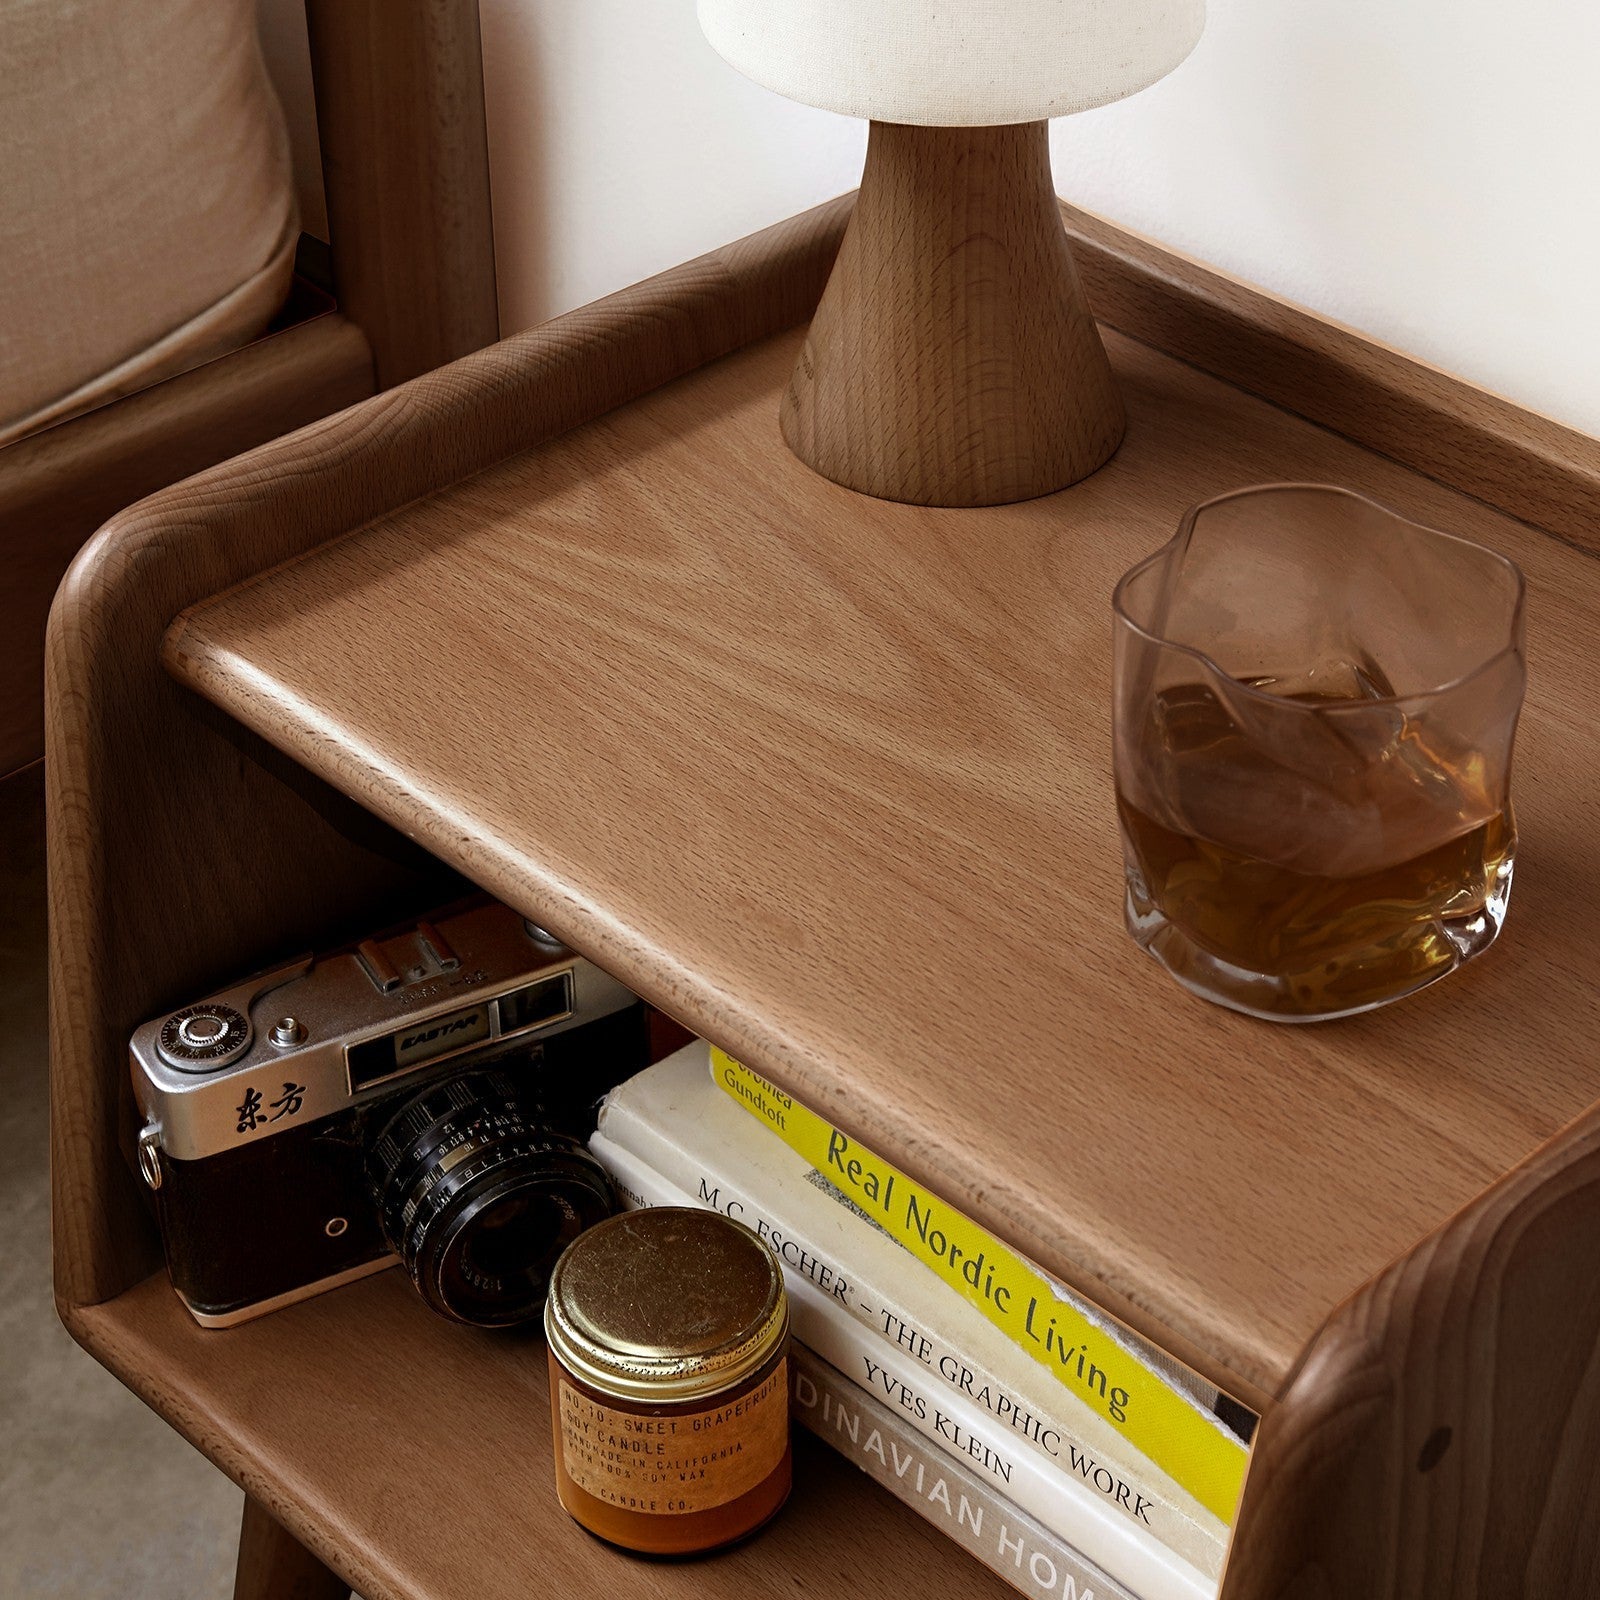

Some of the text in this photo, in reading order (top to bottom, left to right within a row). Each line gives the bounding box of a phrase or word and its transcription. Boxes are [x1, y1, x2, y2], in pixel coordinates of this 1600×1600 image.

[401, 1014, 480, 1051] EASTAR
[236, 1082, 307, 1133] 东方
[724, 1068, 787, 1131] Gundtoft
[827, 1128, 1131, 1424] Real Nordic Living
[567, 1408, 666, 1456] SOY CANDLE
[624, 1418, 678, 1435] SWEET
[863, 1356, 1014, 1484] YVES KLEIN
[880, 1308, 934, 1365] THE
[939, 1355, 1062, 1457] GRAPHIC
[1069, 1444, 1156, 1526] WORK
[632, 1458, 647, 1469] IN
[656, 1442, 744, 1470] CALIFORNIA
[641, 1473, 668, 1483] SOY
[679, 1469, 706, 1482] WAX
[600, 1488, 658, 1511] CANDLE
[668, 1501, 694, 1511] CO.
